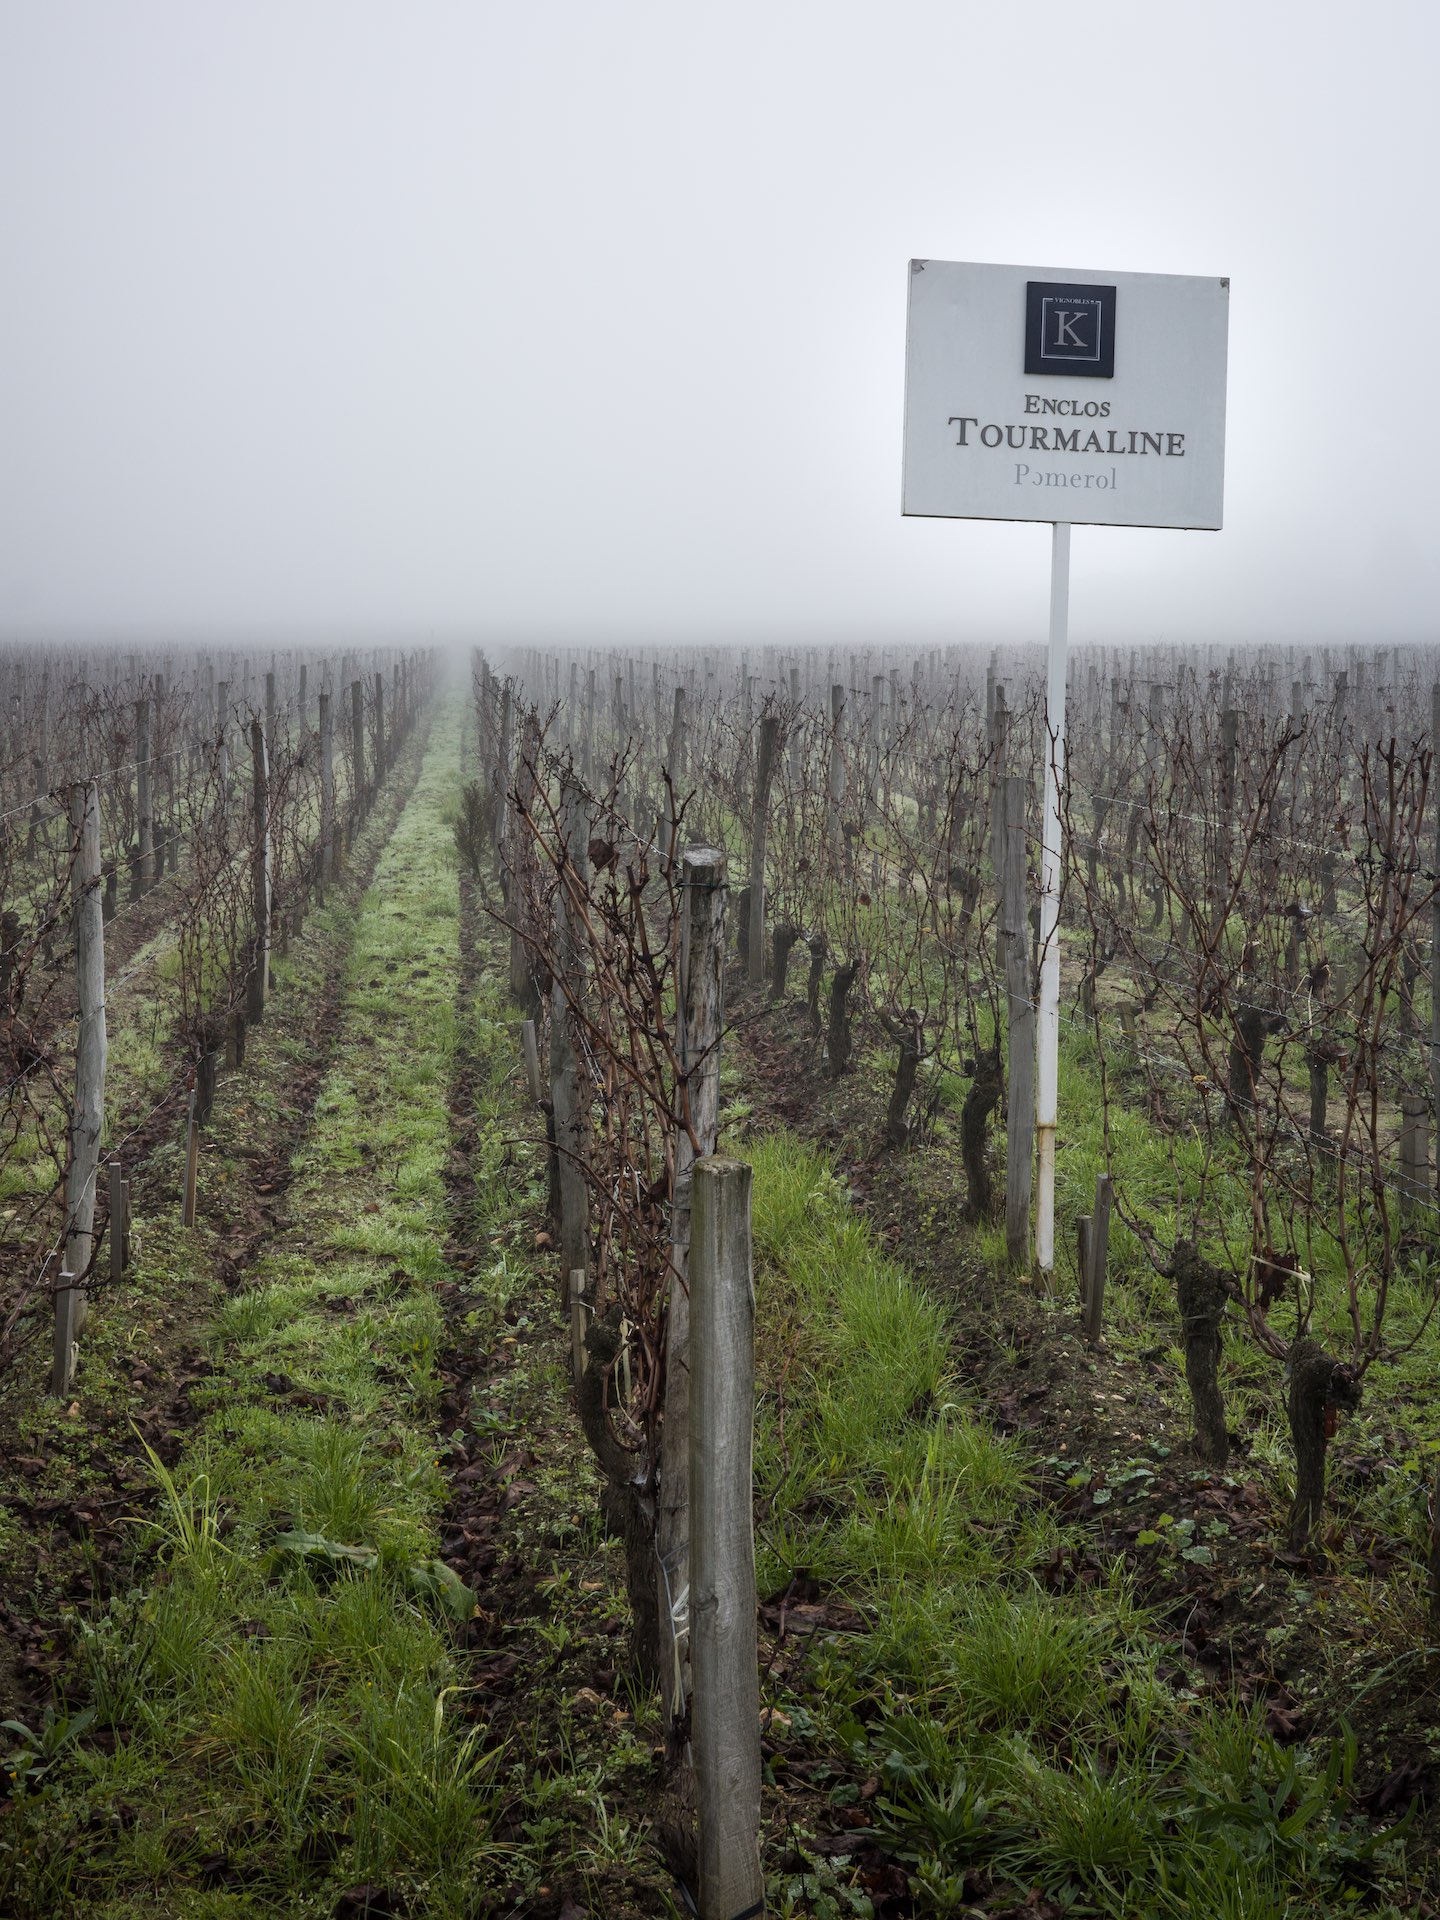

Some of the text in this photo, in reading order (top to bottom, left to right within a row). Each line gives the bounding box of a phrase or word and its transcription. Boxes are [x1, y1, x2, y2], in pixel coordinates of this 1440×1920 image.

[1053, 310, 1089, 347] K
[1024, 394, 1111, 417] ENCLOS
[948, 416, 1185, 456] TOURMALINE
